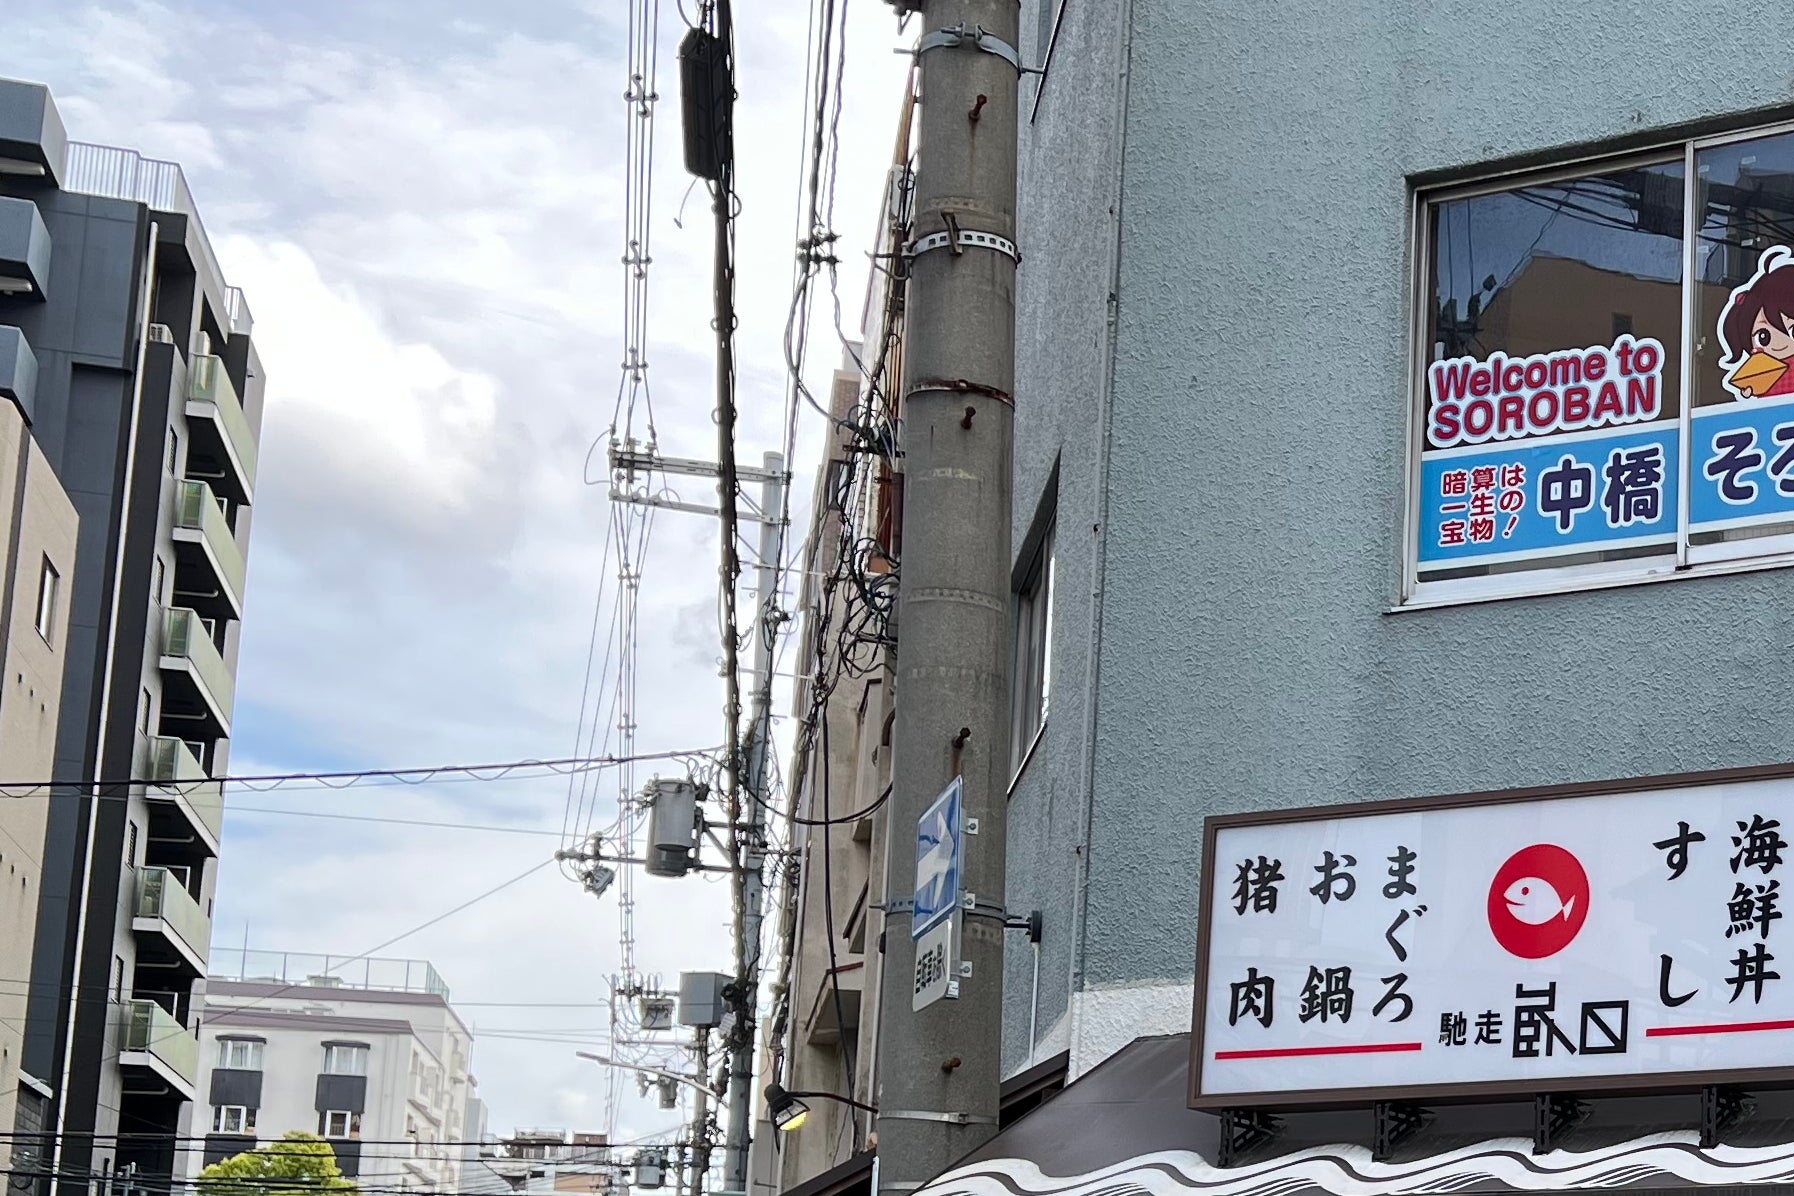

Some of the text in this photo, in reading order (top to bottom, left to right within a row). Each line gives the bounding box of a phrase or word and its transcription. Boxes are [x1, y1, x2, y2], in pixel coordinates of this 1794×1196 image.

[1434, 376, 1656, 440] SOROBAN
[1435, 340, 1658, 402] Welcome to
[1441, 490, 1524, 517] 一生の
[1443, 464, 1525, 495] 暗算は
[1541, 447, 1662, 530] 中橋
[1229, 855, 1285, 1028] 猪肉
[1299, 851, 1357, 1024] お鍋
[1372, 845, 1428, 1023] まぐろ
[1652, 821, 1706, 1008] すし
[1724, 814, 1788, 1005] 海鮮丼
